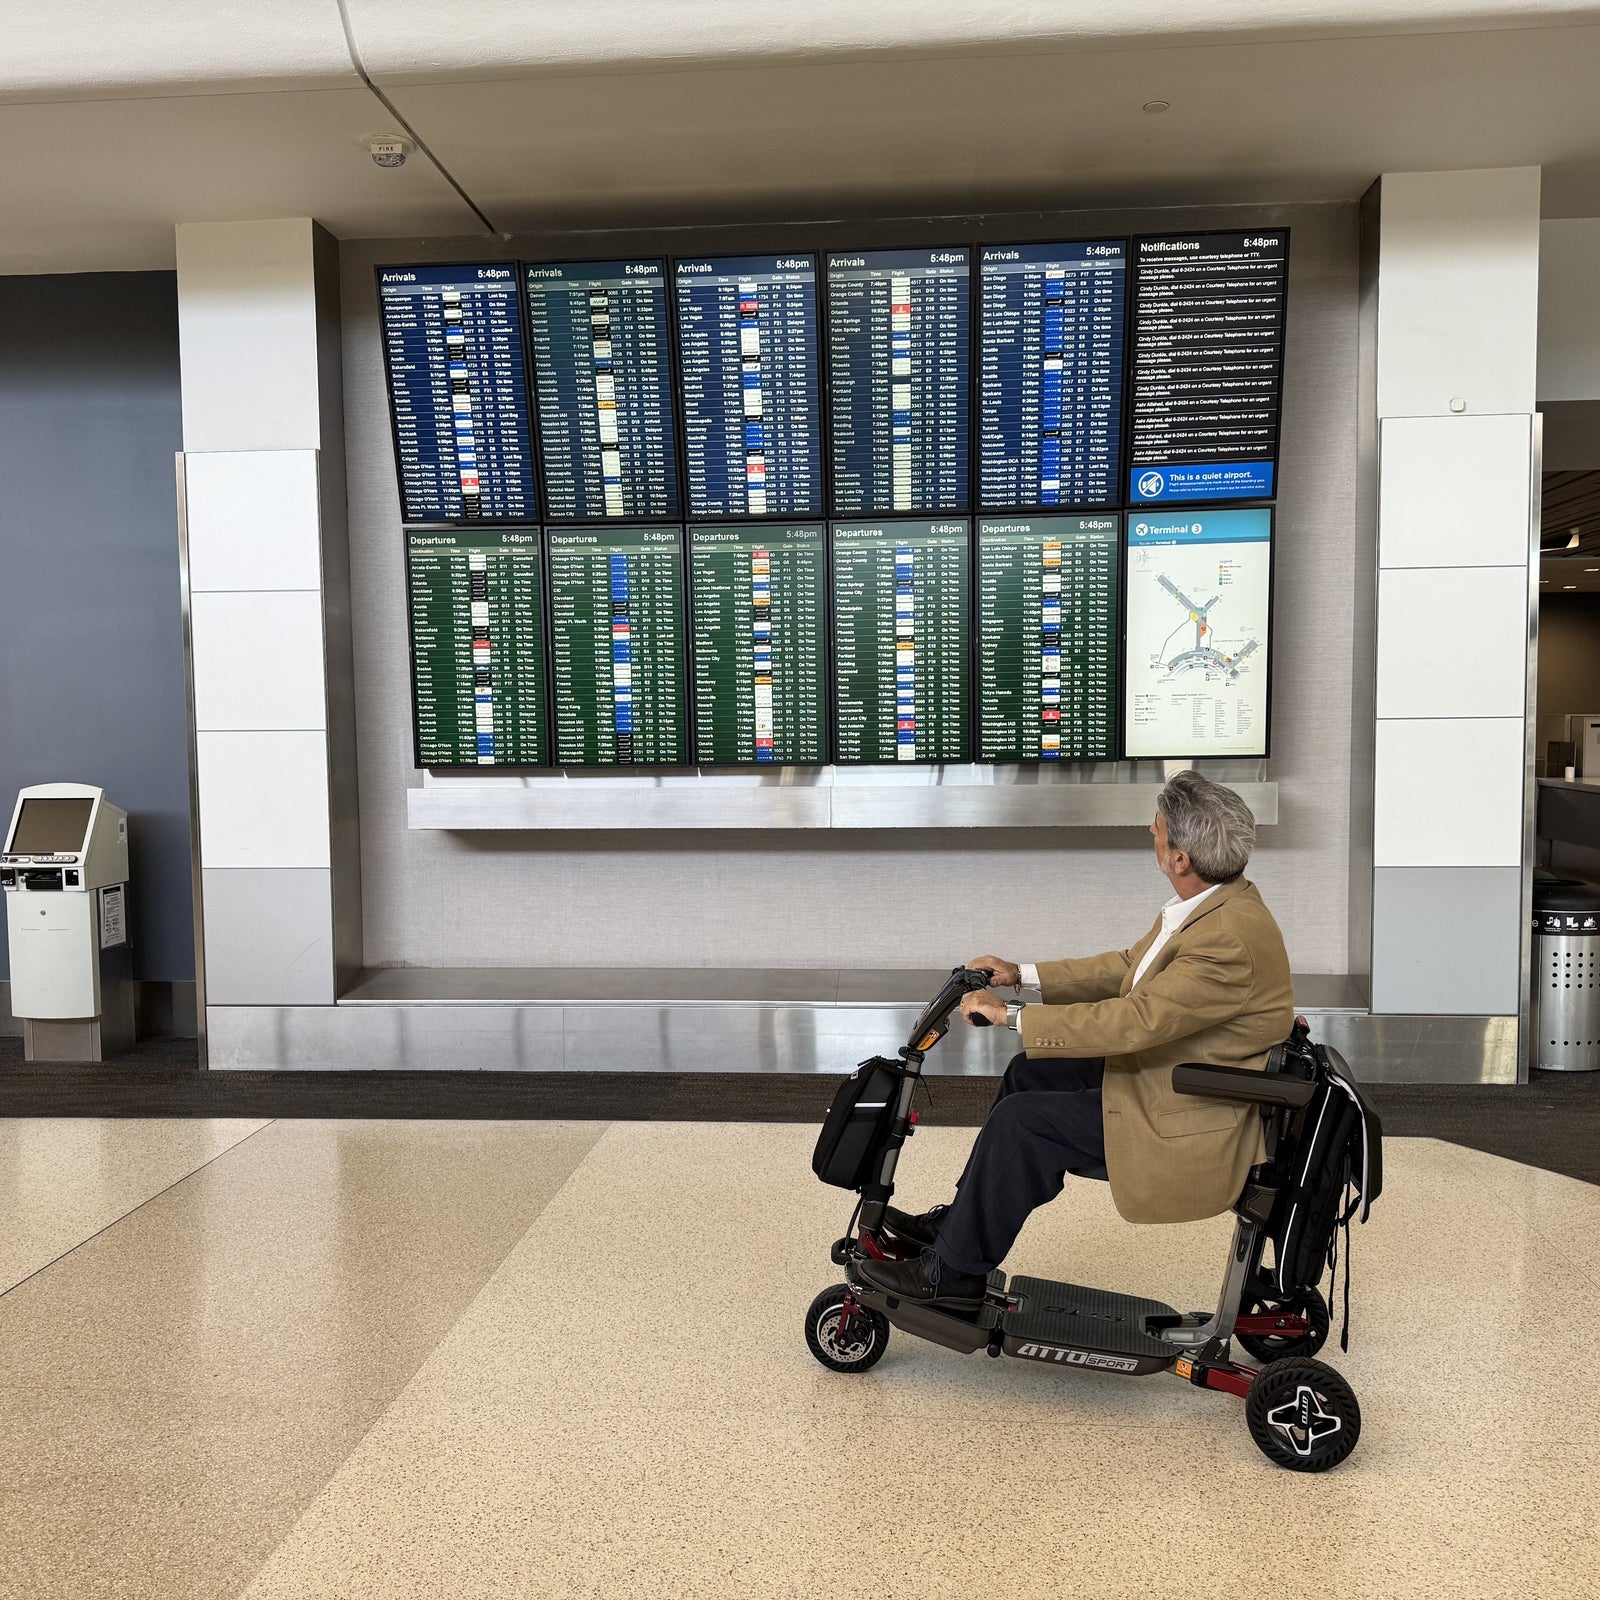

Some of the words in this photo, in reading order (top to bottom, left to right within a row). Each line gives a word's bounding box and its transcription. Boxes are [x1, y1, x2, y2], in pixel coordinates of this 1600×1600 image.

[1140, 241, 1200, 252] Notifications
[1243, 238, 1279, 249] 5:48pm
[983, 250, 1020, 261] Arrivals
[1085, 246, 1121, 257] 5:48pm
[829, 258, 866, 268] Arrivals
[930, 253, 964, 264] 5:48pm
[625, 264, 658, 275] 5:48pm
[677, 263, 713, 273] Arrivals
[776, 259, 810, 270] 5:48pm
[382, 272, 416, 282] Arrivals
[477, 269, 510, 279] 5:48pm
[528, 268, 563, 278] Arrivals
[1169, 473, 1185, 481] This
[1201, 472, 1222, 481] quiet
[1223, 471, 1253, 480] airport.
[930, 525, 963, 535] 5:48pm
[982, 524, 1031, 534] Departures
[1079, 520, 1113, 530] 5:48pm
[1149, 524, 1188, 535] Terminal
[502, 534, 533, 544] 5:48pm
[643, 533, 675, 543] 5:48pm
[693, 533, 740, 542] Departures
[786, 530, 818, 539] 5:48pm
[835, 529, 884, 539] Departures
[410, 536, 456, 546] Departures
[551, 535, 598, 545] Departures
[1016, 1342, 1089, 1365] ATTO
[1086, 1356, 1136, 1370] SPORT
[1301, 1395, 1309, 1425] ATTO
